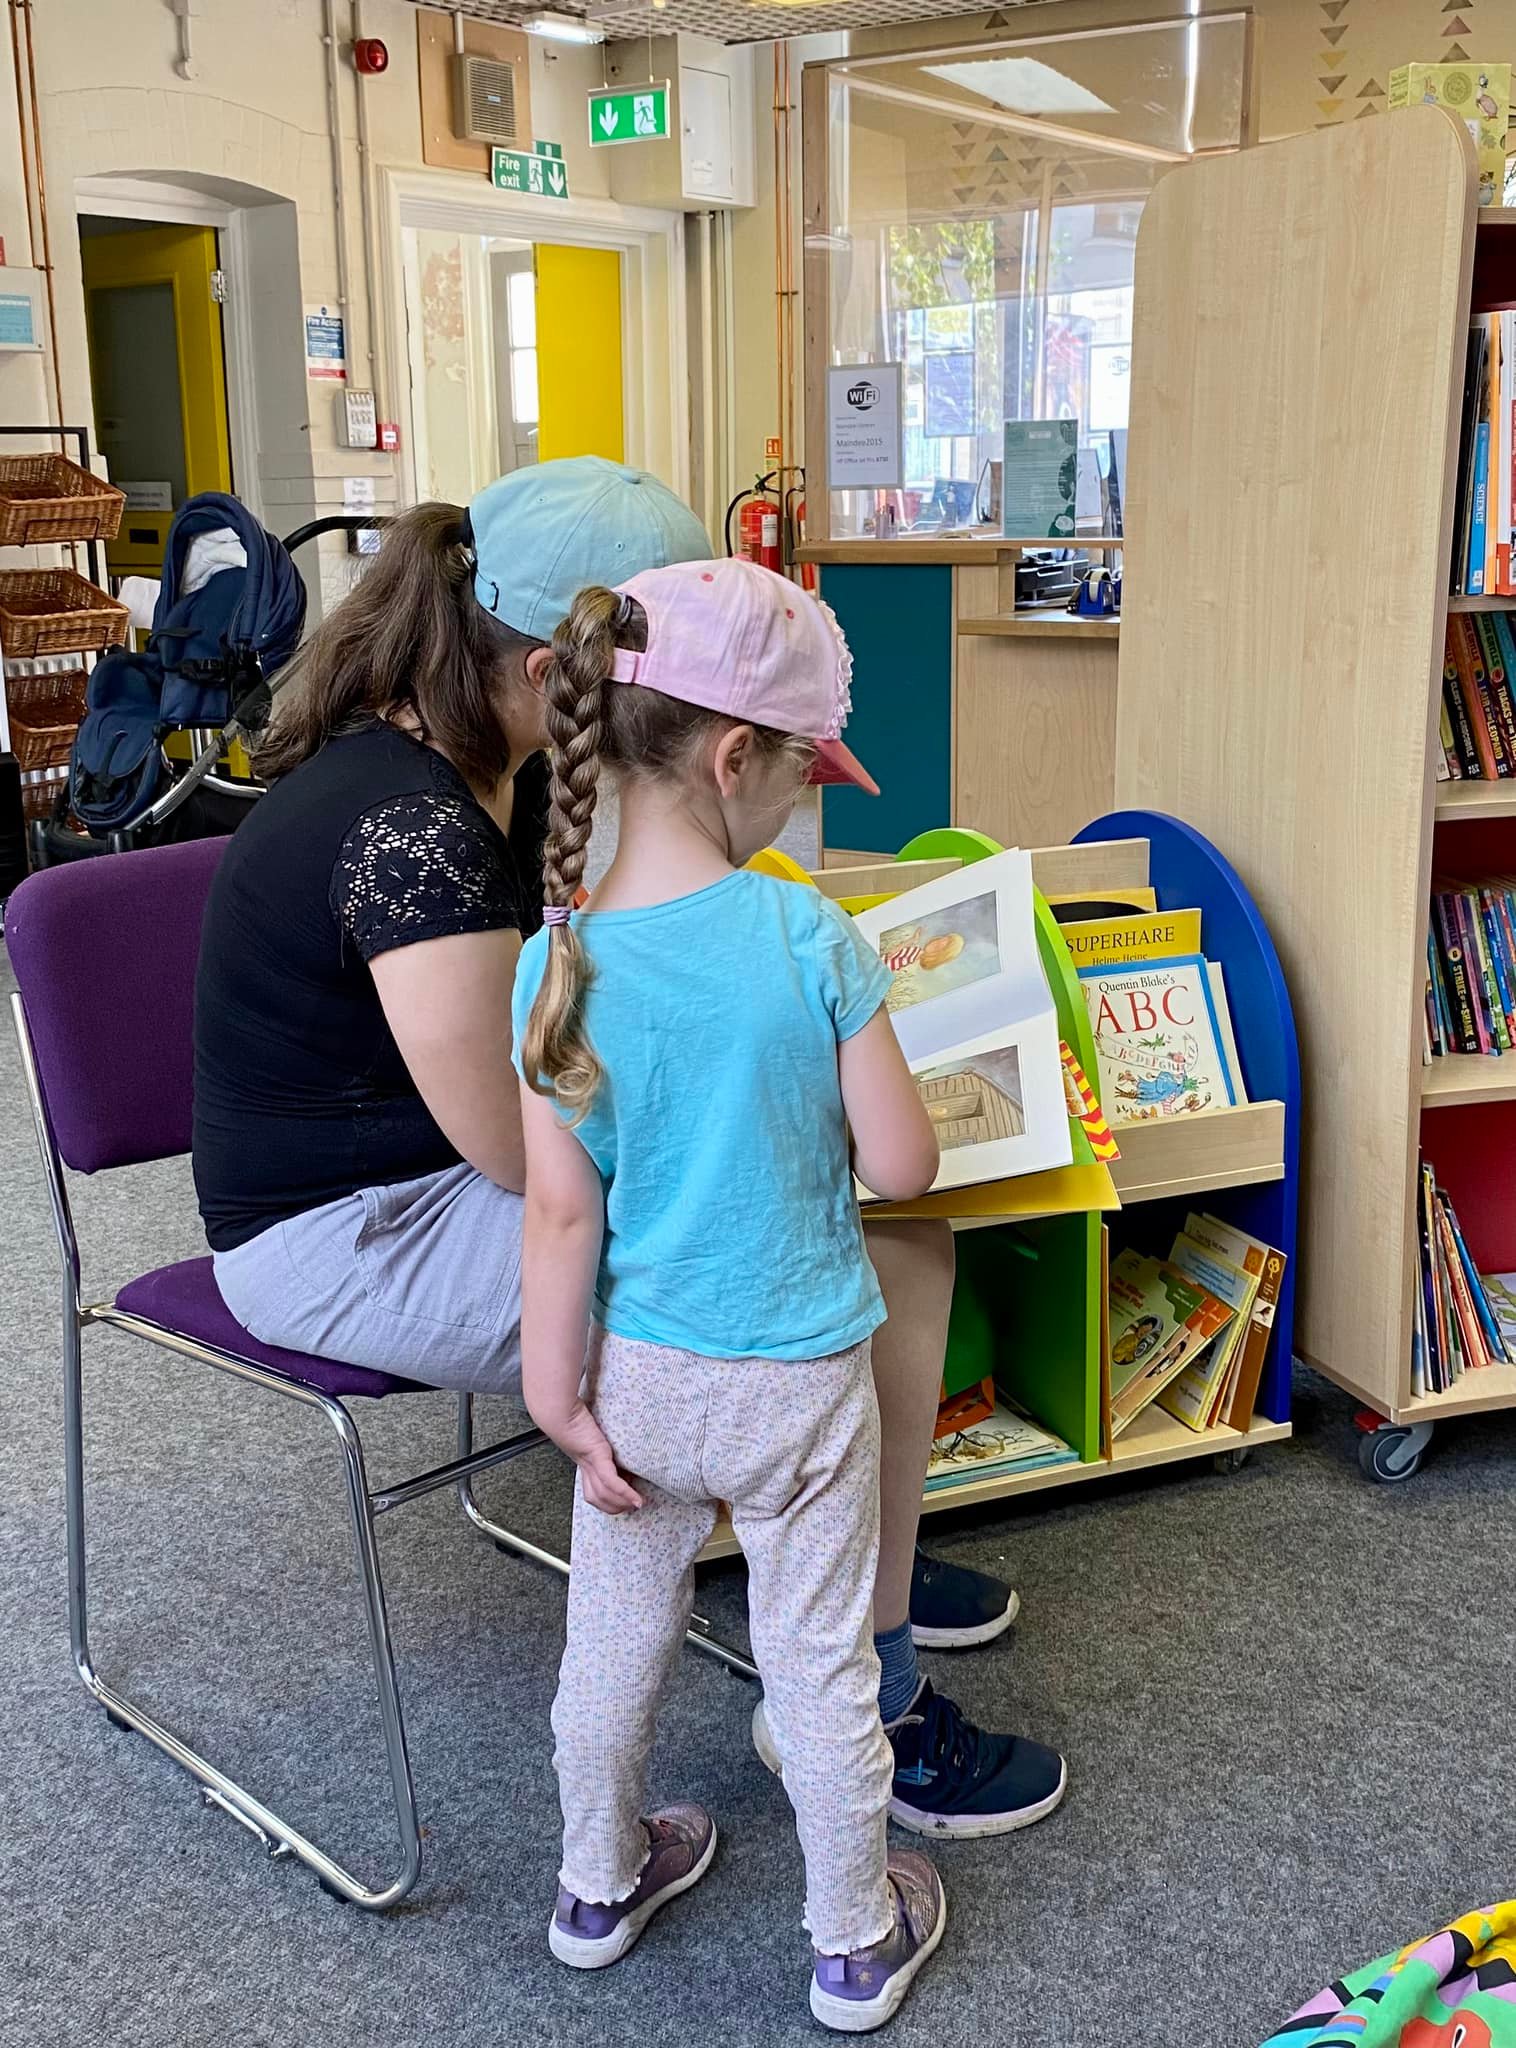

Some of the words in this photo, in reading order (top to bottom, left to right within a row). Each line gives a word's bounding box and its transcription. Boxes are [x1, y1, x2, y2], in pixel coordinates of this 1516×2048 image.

[499, 154, 520, 171] Fire
[500, 174, 520, 188] exit
[308, 317, 320, 326] Fire
[1475, 483, 1486, 525] SCIENCE
[1497, 685, 1512, 719] TRACKS
[1487, 720, 1503, 759] LEOPARD
[1066, 926, 1175, 953] SUPERHARE
[1092, 955, 1120, 966] Helme
[1098, 978, 1139, 994] Quentin
[1140, 974, 1175, 988] Blake's
[1096, 985, 1194, 1034] ABC
[1453, 964, 1466, 995] STRIKE
[1461, 1009, 1474, 1037] SHARK
